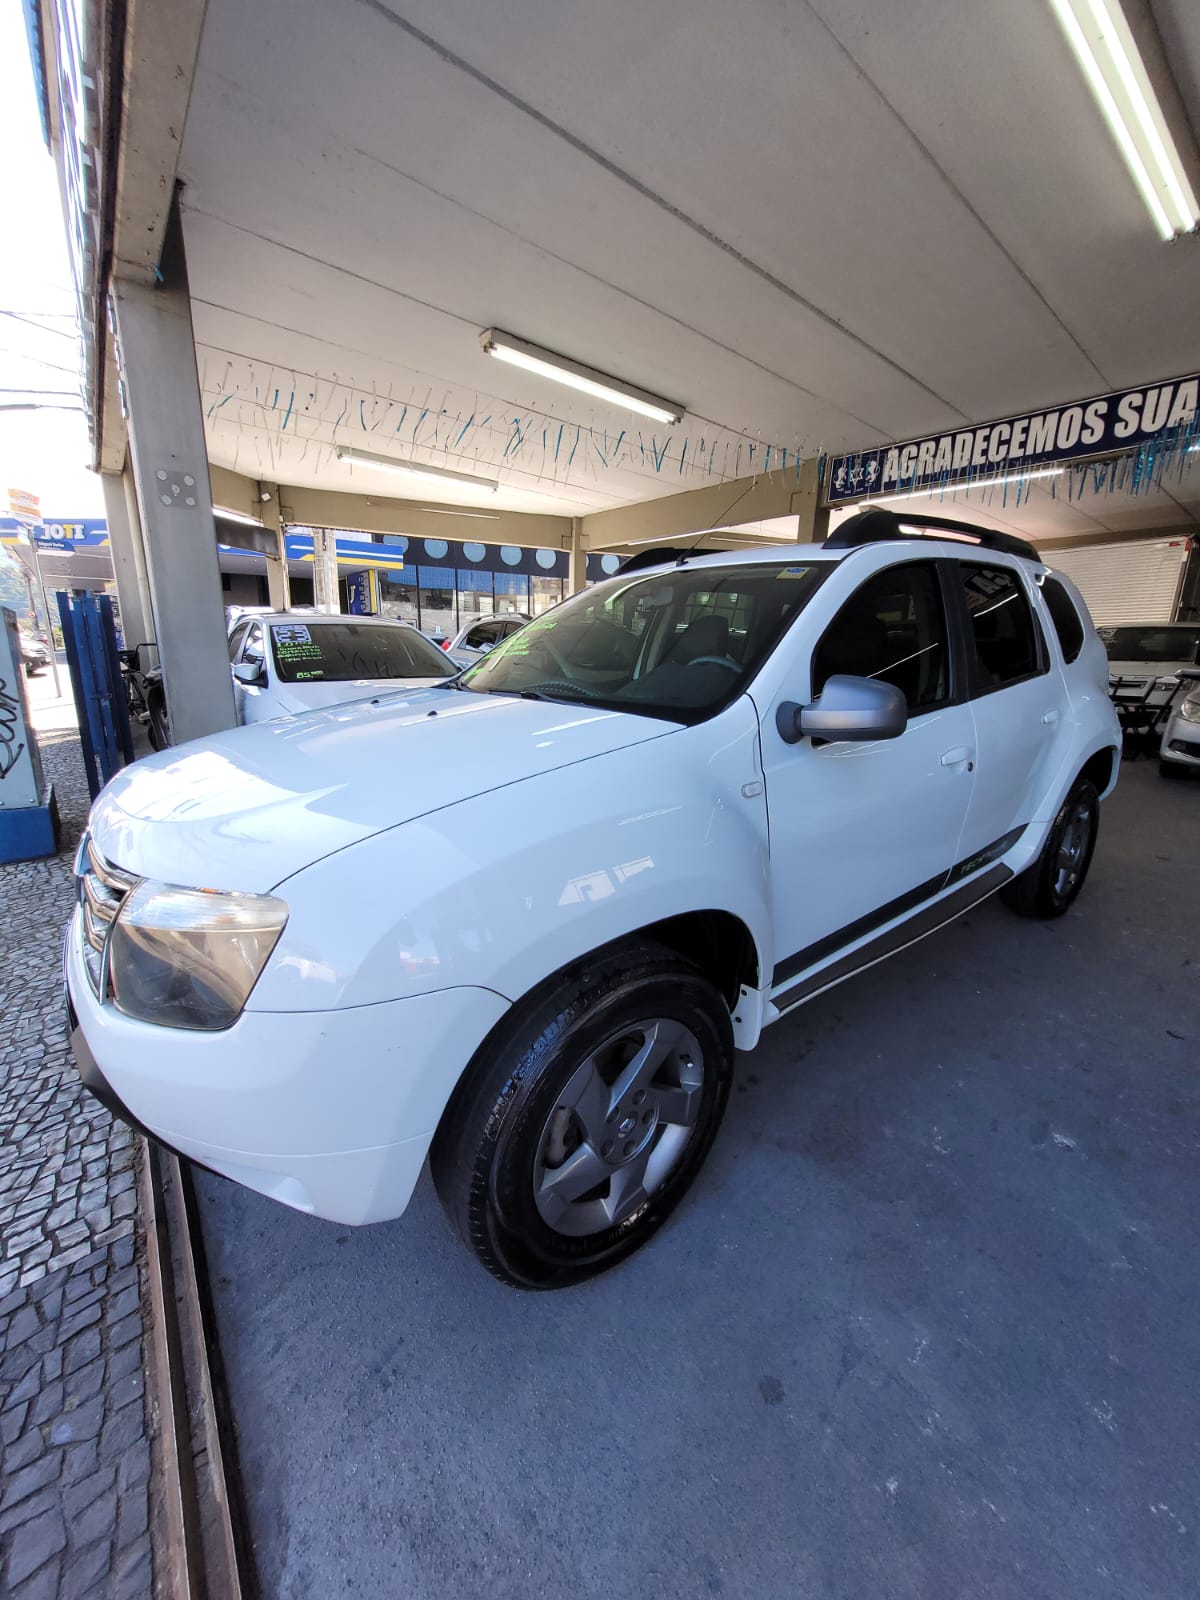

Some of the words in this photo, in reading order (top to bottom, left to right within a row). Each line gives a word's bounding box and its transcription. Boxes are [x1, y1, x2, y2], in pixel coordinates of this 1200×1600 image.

[882, 400, 1109, 483] AGRADECEMOS
[1113, 378, 1199, 439] SUA
[40, 523, 86, 540] JOTI
